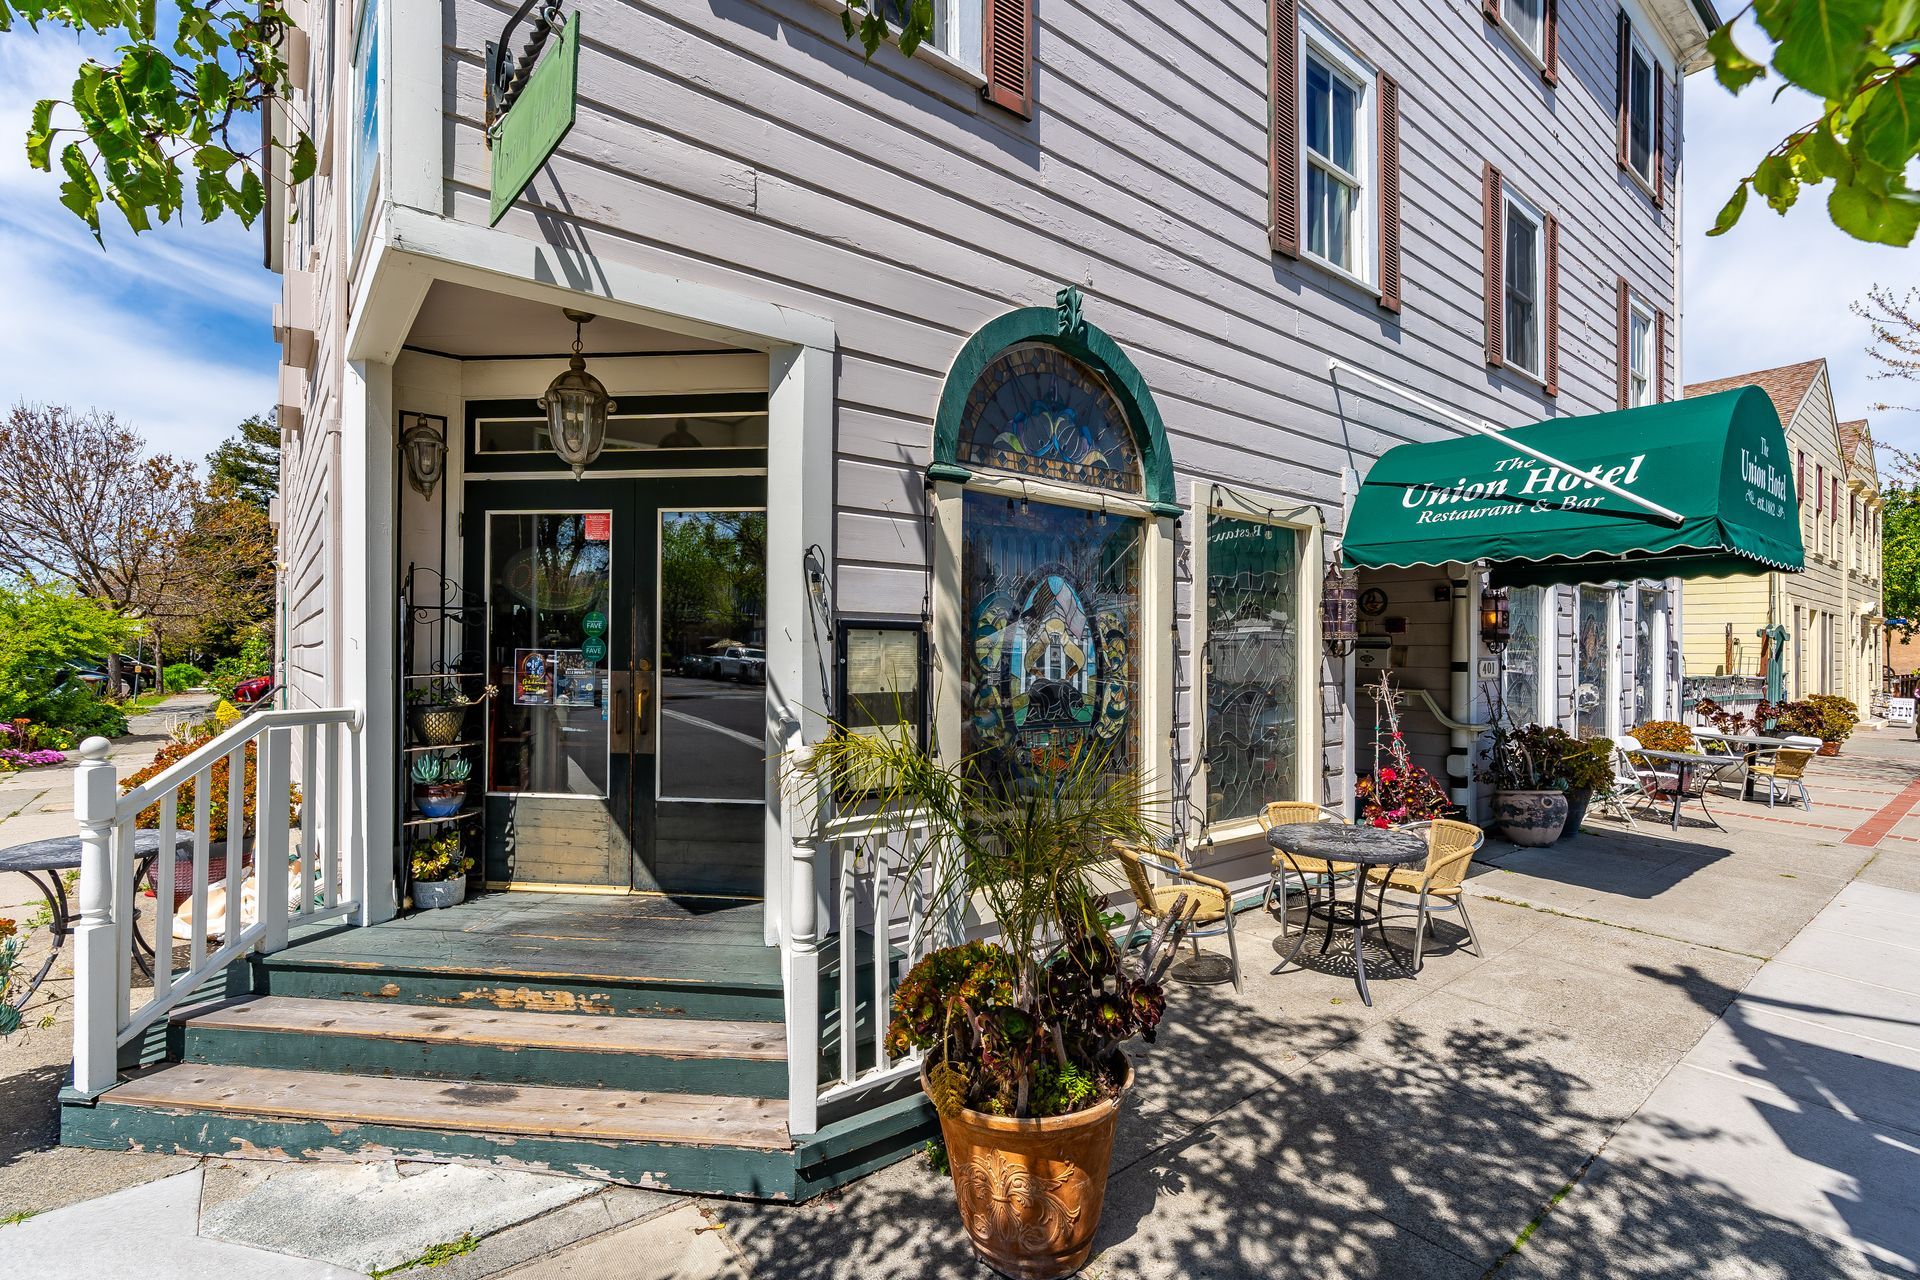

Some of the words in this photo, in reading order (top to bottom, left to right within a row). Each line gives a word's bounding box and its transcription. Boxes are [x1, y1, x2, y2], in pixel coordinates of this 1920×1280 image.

[1760, 436, 1769, 458] The
[1493, 457, 1537, 472] The
[1741, 448, 1766, 490] Union
[1767, 464, 1787, 502] Hotel
[1402, 478, 1509, 509] Union
[1518, 454, 1646, 495] Hotel
[1416, 502, 1525, 525] Restaurant
[1530, 498, 1552, 513] &
[1558, 495, 1606, 511] Bar
[1482, 662, 1495, 675] 401
